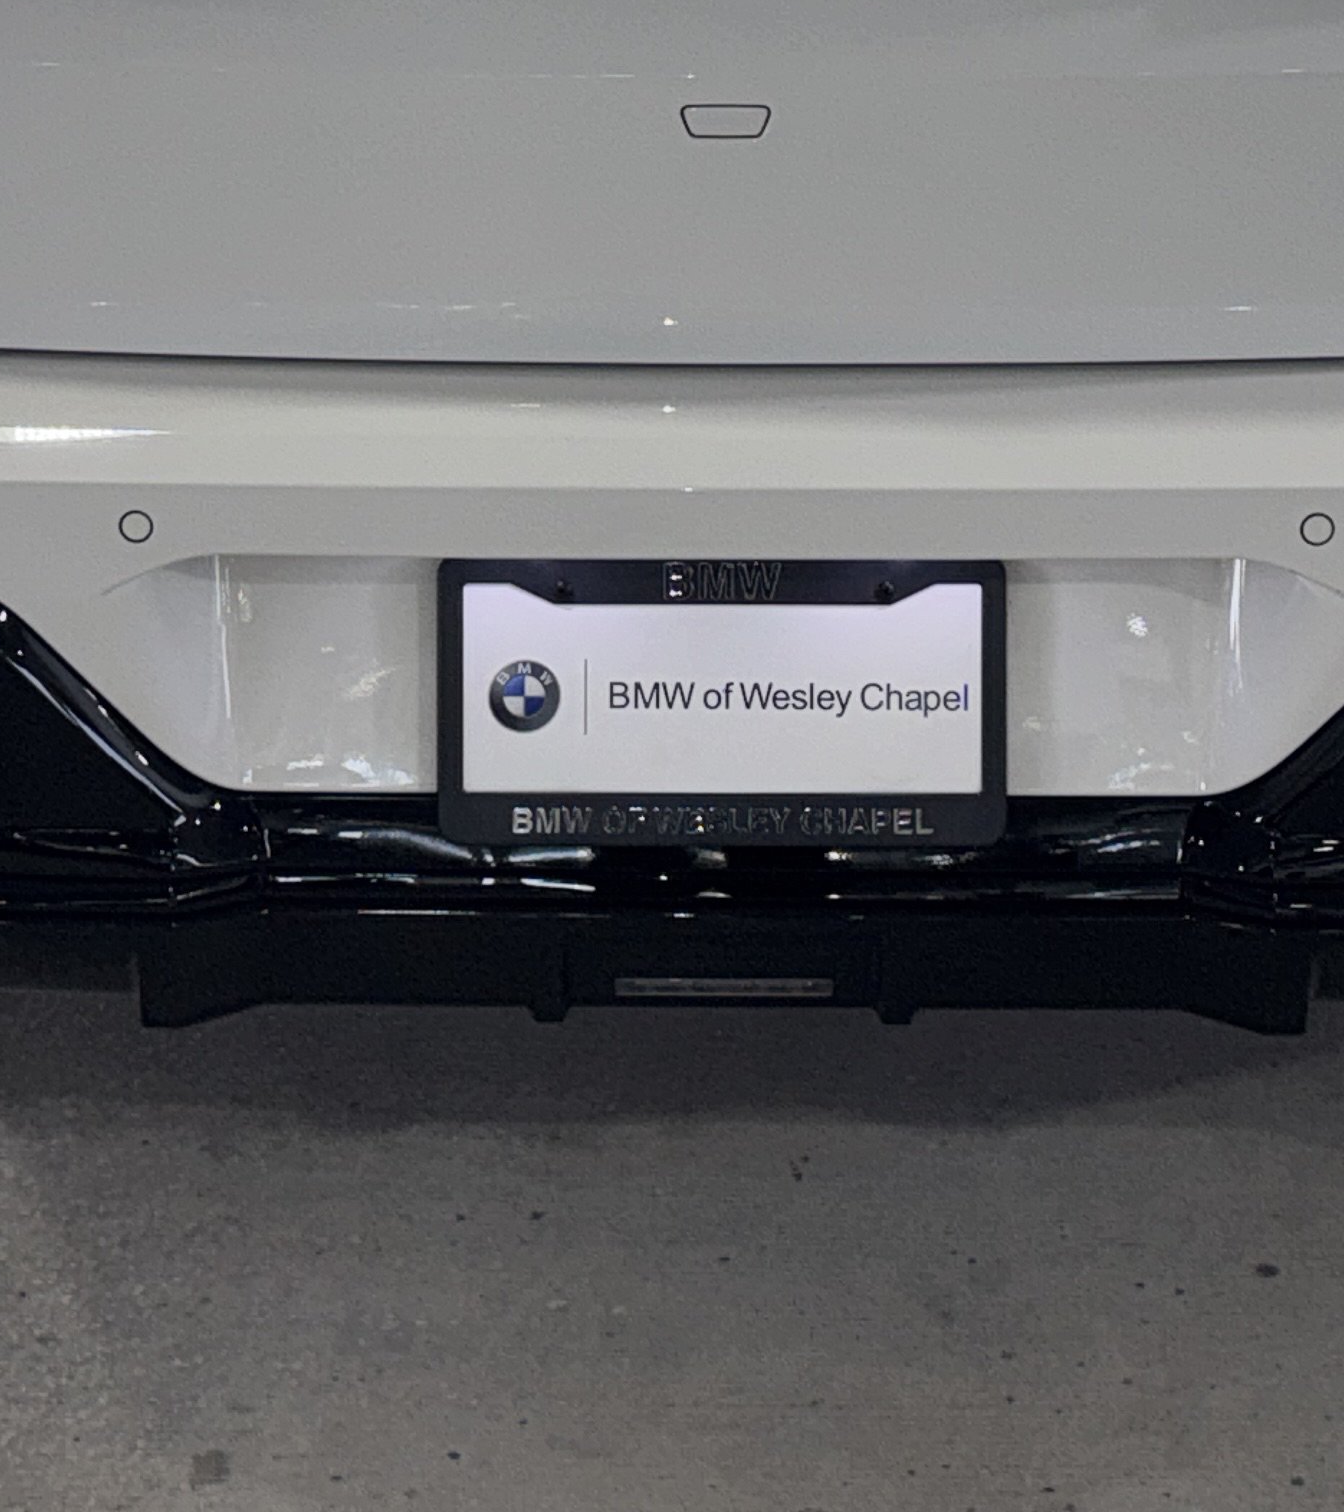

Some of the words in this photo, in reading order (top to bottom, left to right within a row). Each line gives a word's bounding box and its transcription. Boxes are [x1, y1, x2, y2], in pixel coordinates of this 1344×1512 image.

[663, 561, 781, 601] BMW
[497, 663, 553, 686] BMW
[609, 681, 695, 710] BMW
[703, 681, 734, 710] of
[739, 681, 853, 718] Wesley
[860, 682, 969, 718] Chapel
[512, 806, 593, 834] BMW
[799, 806, 935, 835] CHAPEL
